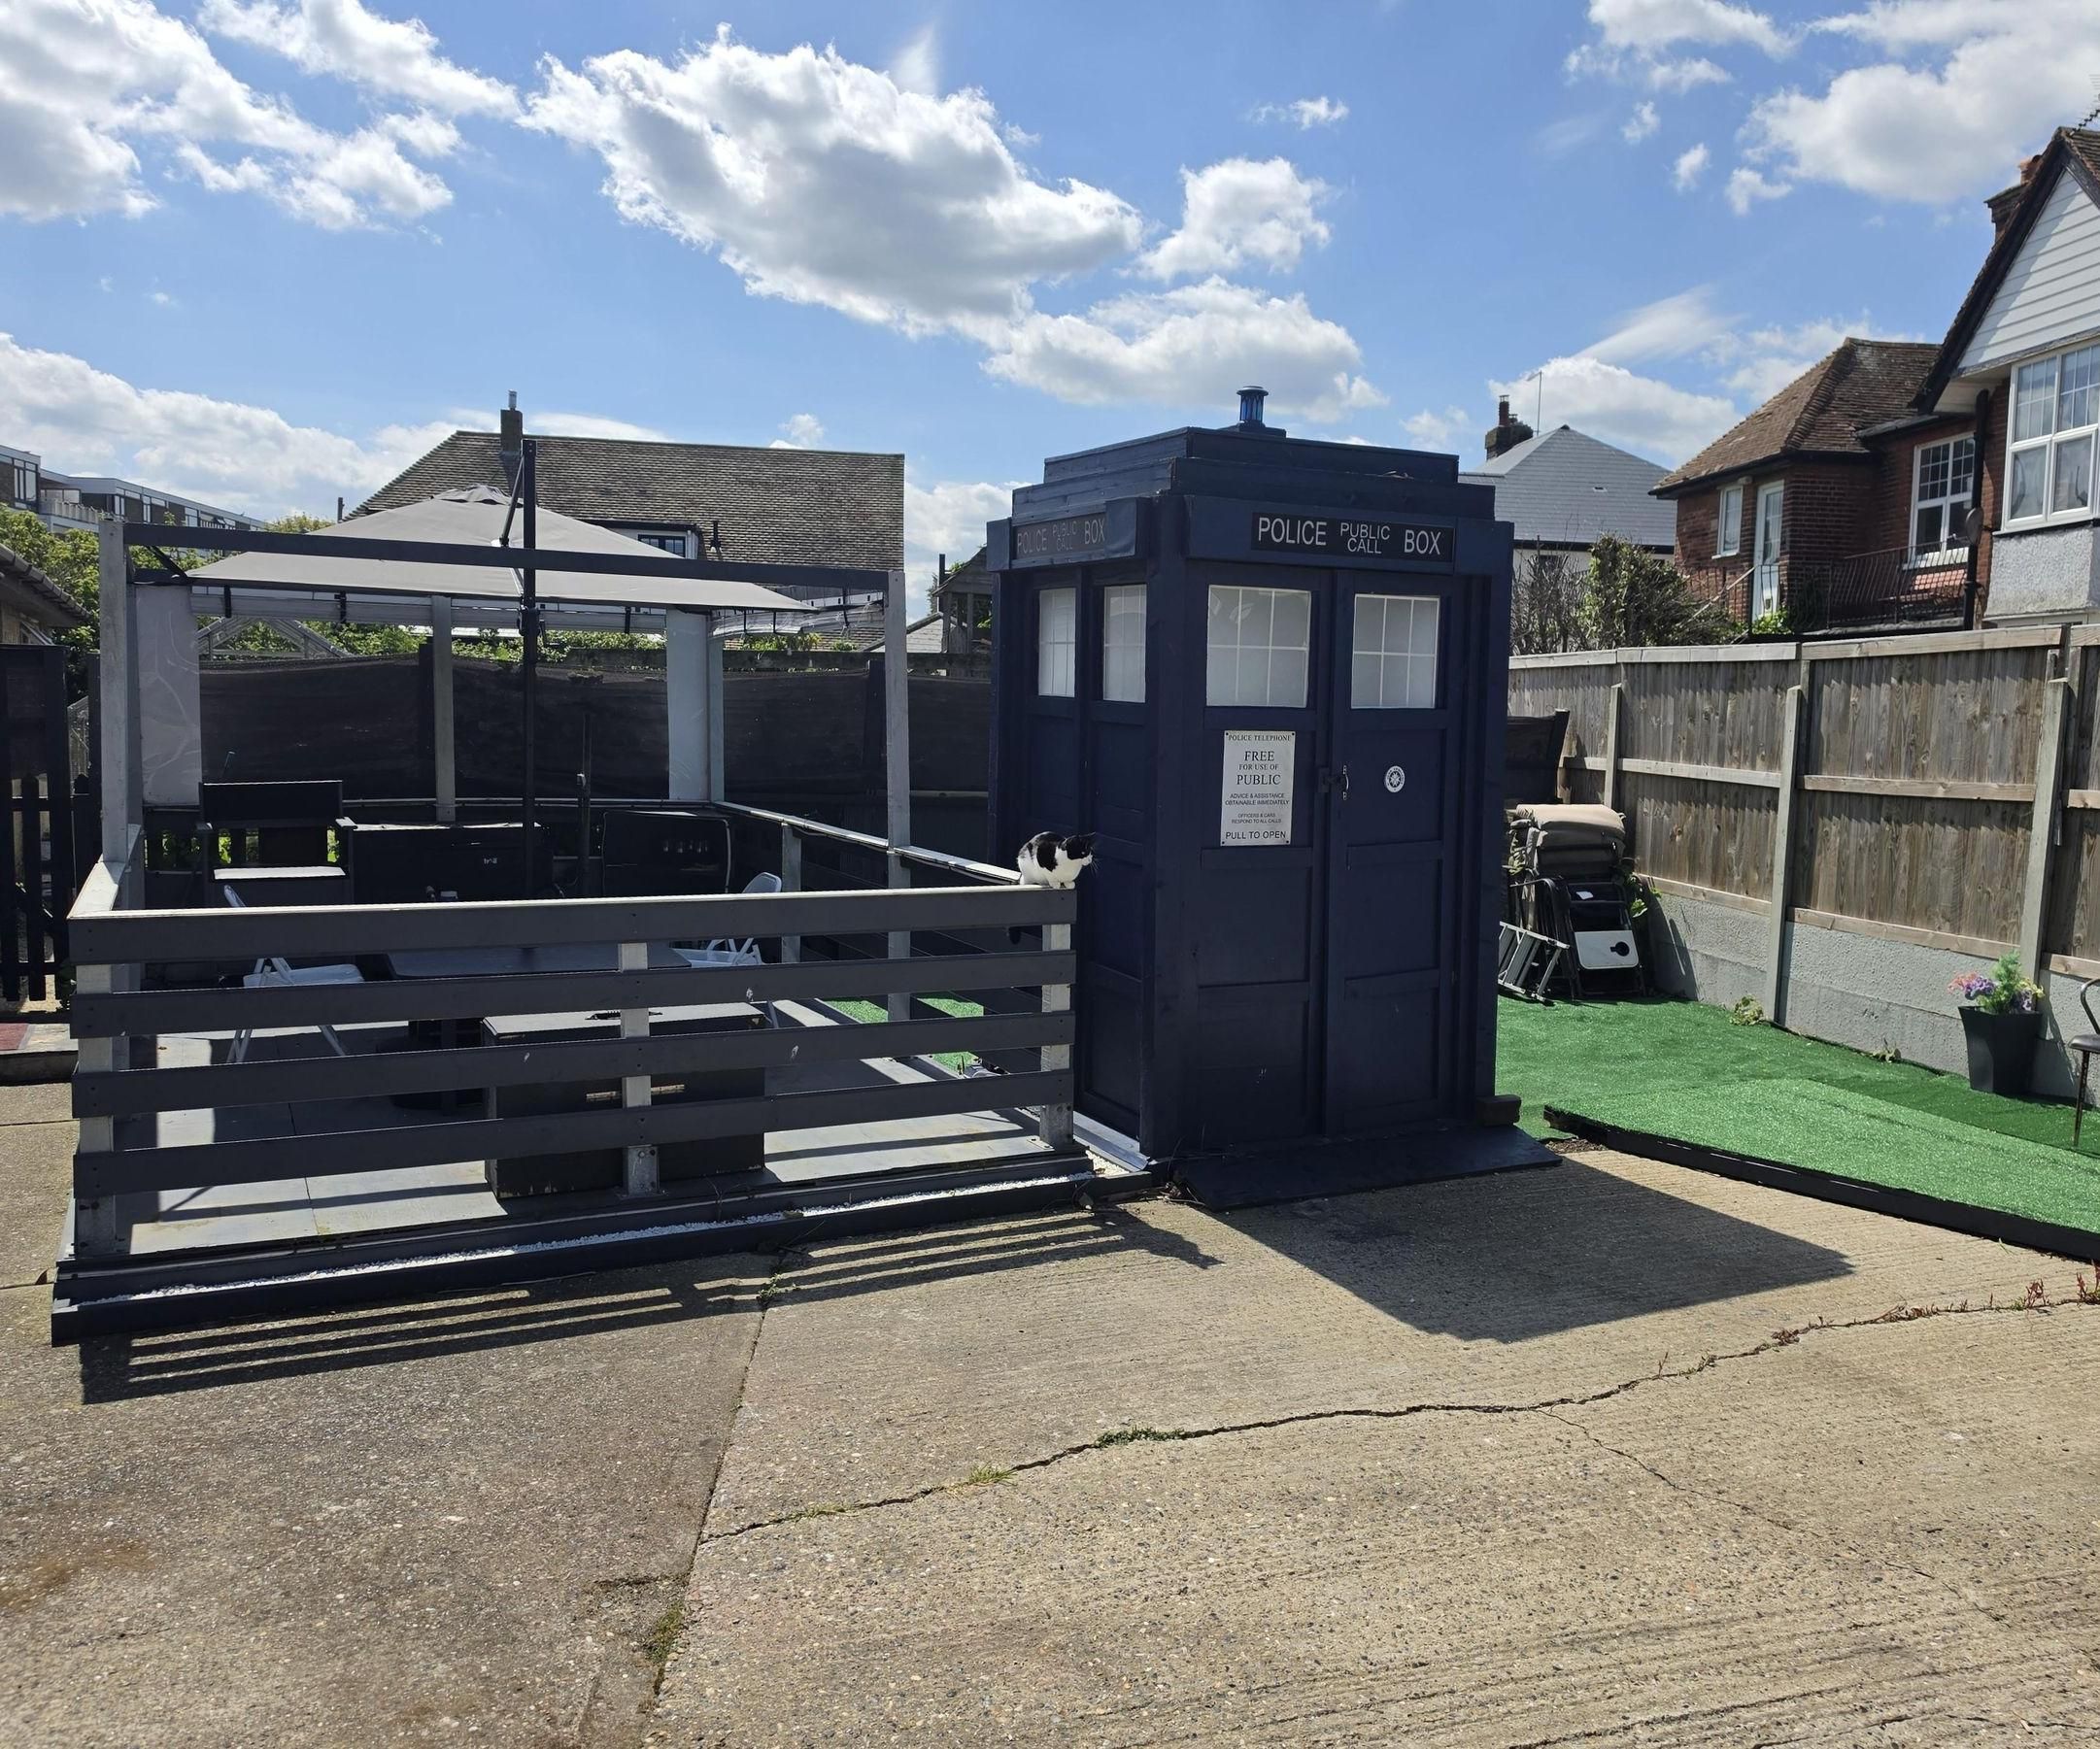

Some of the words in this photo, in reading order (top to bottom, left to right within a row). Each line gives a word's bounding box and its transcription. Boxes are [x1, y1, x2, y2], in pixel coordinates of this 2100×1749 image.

[1052, 521, 1077, 537] PUBLIC
[1084, 518, 1105, 545] BOX
[1258, 517, 1328, 546] POLICE
[1339, 522, 1391, 540] PUBLIC
[1017, 528, 1048, 555] POLICE
[1056, 536, 1073, 552] CALL
[1347, 538, 1382, 554] CALL
[1404, 529, 1441, 555] BOX
[1244, 751, 1274, 761] FREE
[1236, 774, 1281, 785] PUBLIC
[1226, 831, 1246, 840] PULL
[1263, 830, 1287, 839] OPEN
